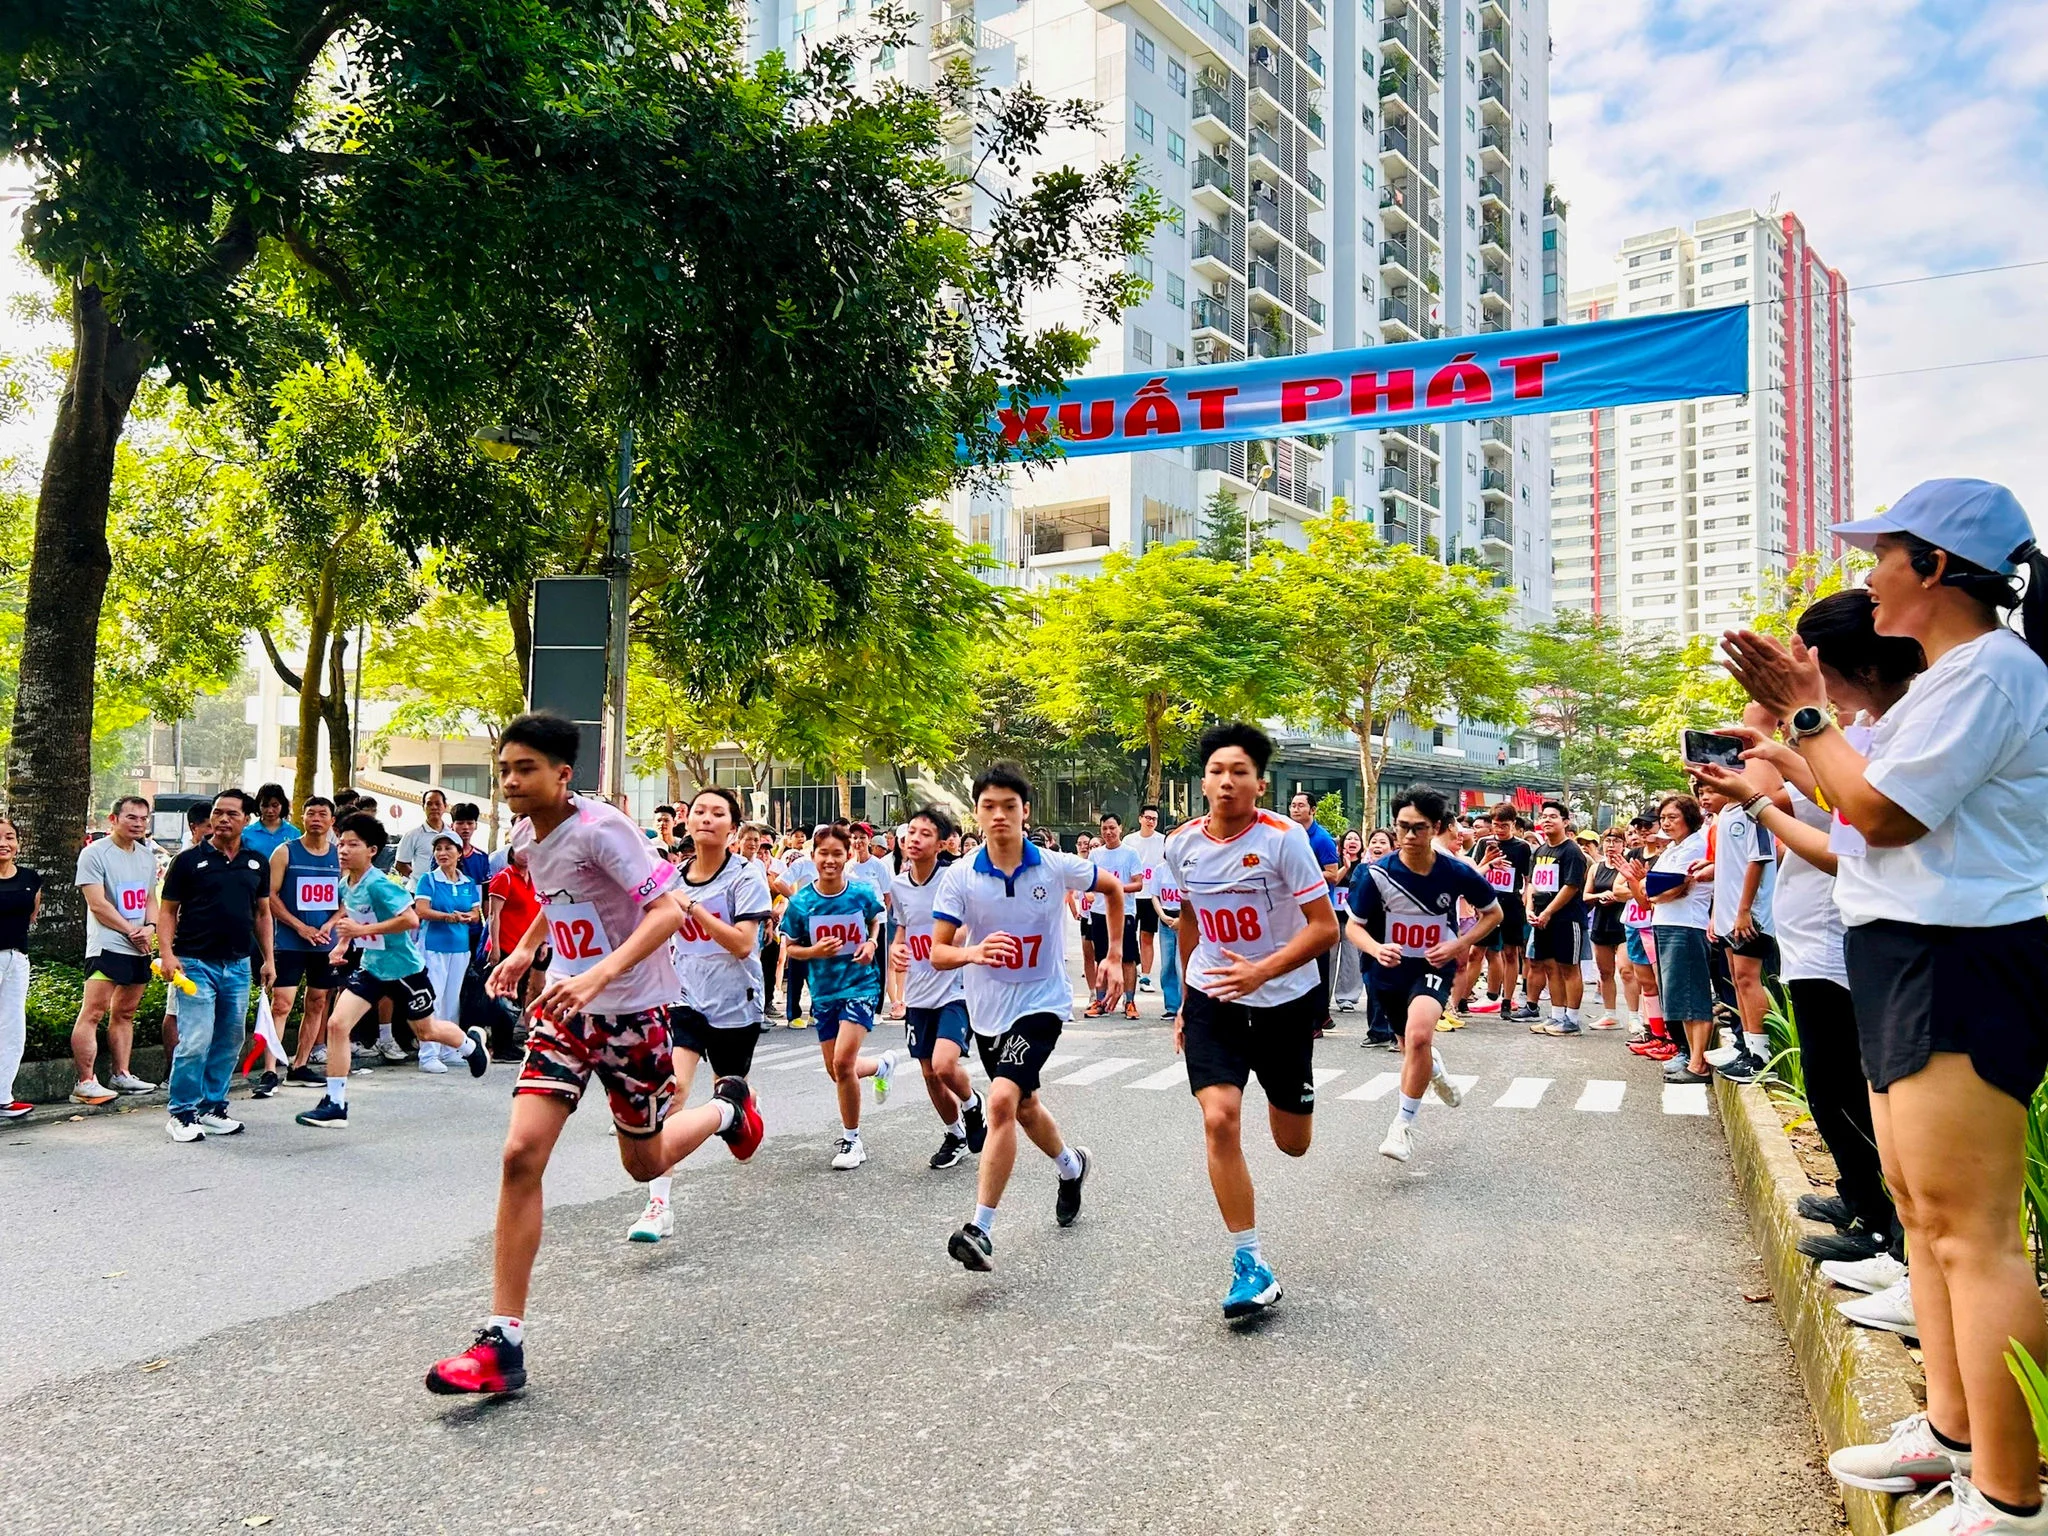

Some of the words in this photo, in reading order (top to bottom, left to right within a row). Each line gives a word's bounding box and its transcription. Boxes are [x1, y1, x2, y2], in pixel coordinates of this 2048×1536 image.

[996, 376, 1240, 446] XUẤT
[1281, 352, 1560, 423] PHÁT
[1487, 869, 1511, 886] 080
[1535, 870, 1553, 885] 081
[301, 884, 334, 902] 098
[1200, 906, 1262, 943] 008
[1392, 922, 1441, 949] 009
[988, 934, 1042, 970] 07
[1425, 973, 1443, 991] 17
[408, 995, 427, 1010] 23
